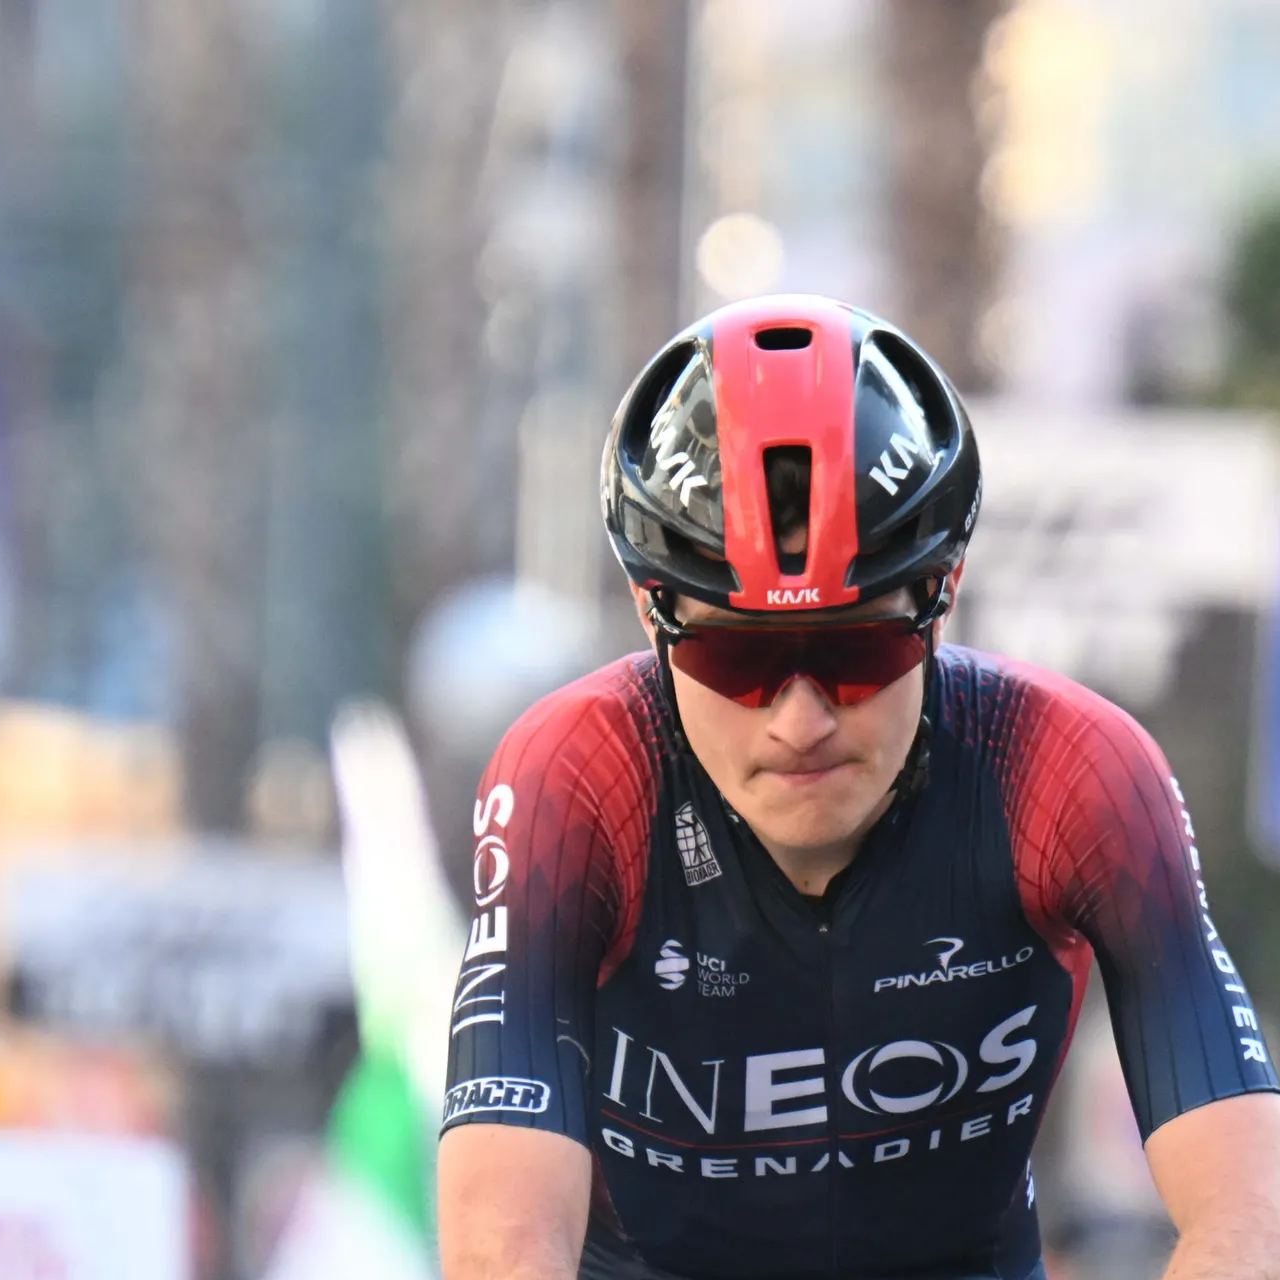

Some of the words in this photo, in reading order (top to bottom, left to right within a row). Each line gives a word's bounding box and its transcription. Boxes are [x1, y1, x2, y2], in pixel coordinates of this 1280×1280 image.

[767, 588, 820, 605] KASK
[452, 783, 515, 1041] INEOS
[696, 952, 726, 973] UCI
[697, 967, 750, 986] WORLD
[874, 946, 1034, 993] PINARELLO
[697, 981, 736, 997] TEAM
[602, 1004, 1038, 1136] INEOS
[601, 1094, 1034, 1179] GRENADIER
